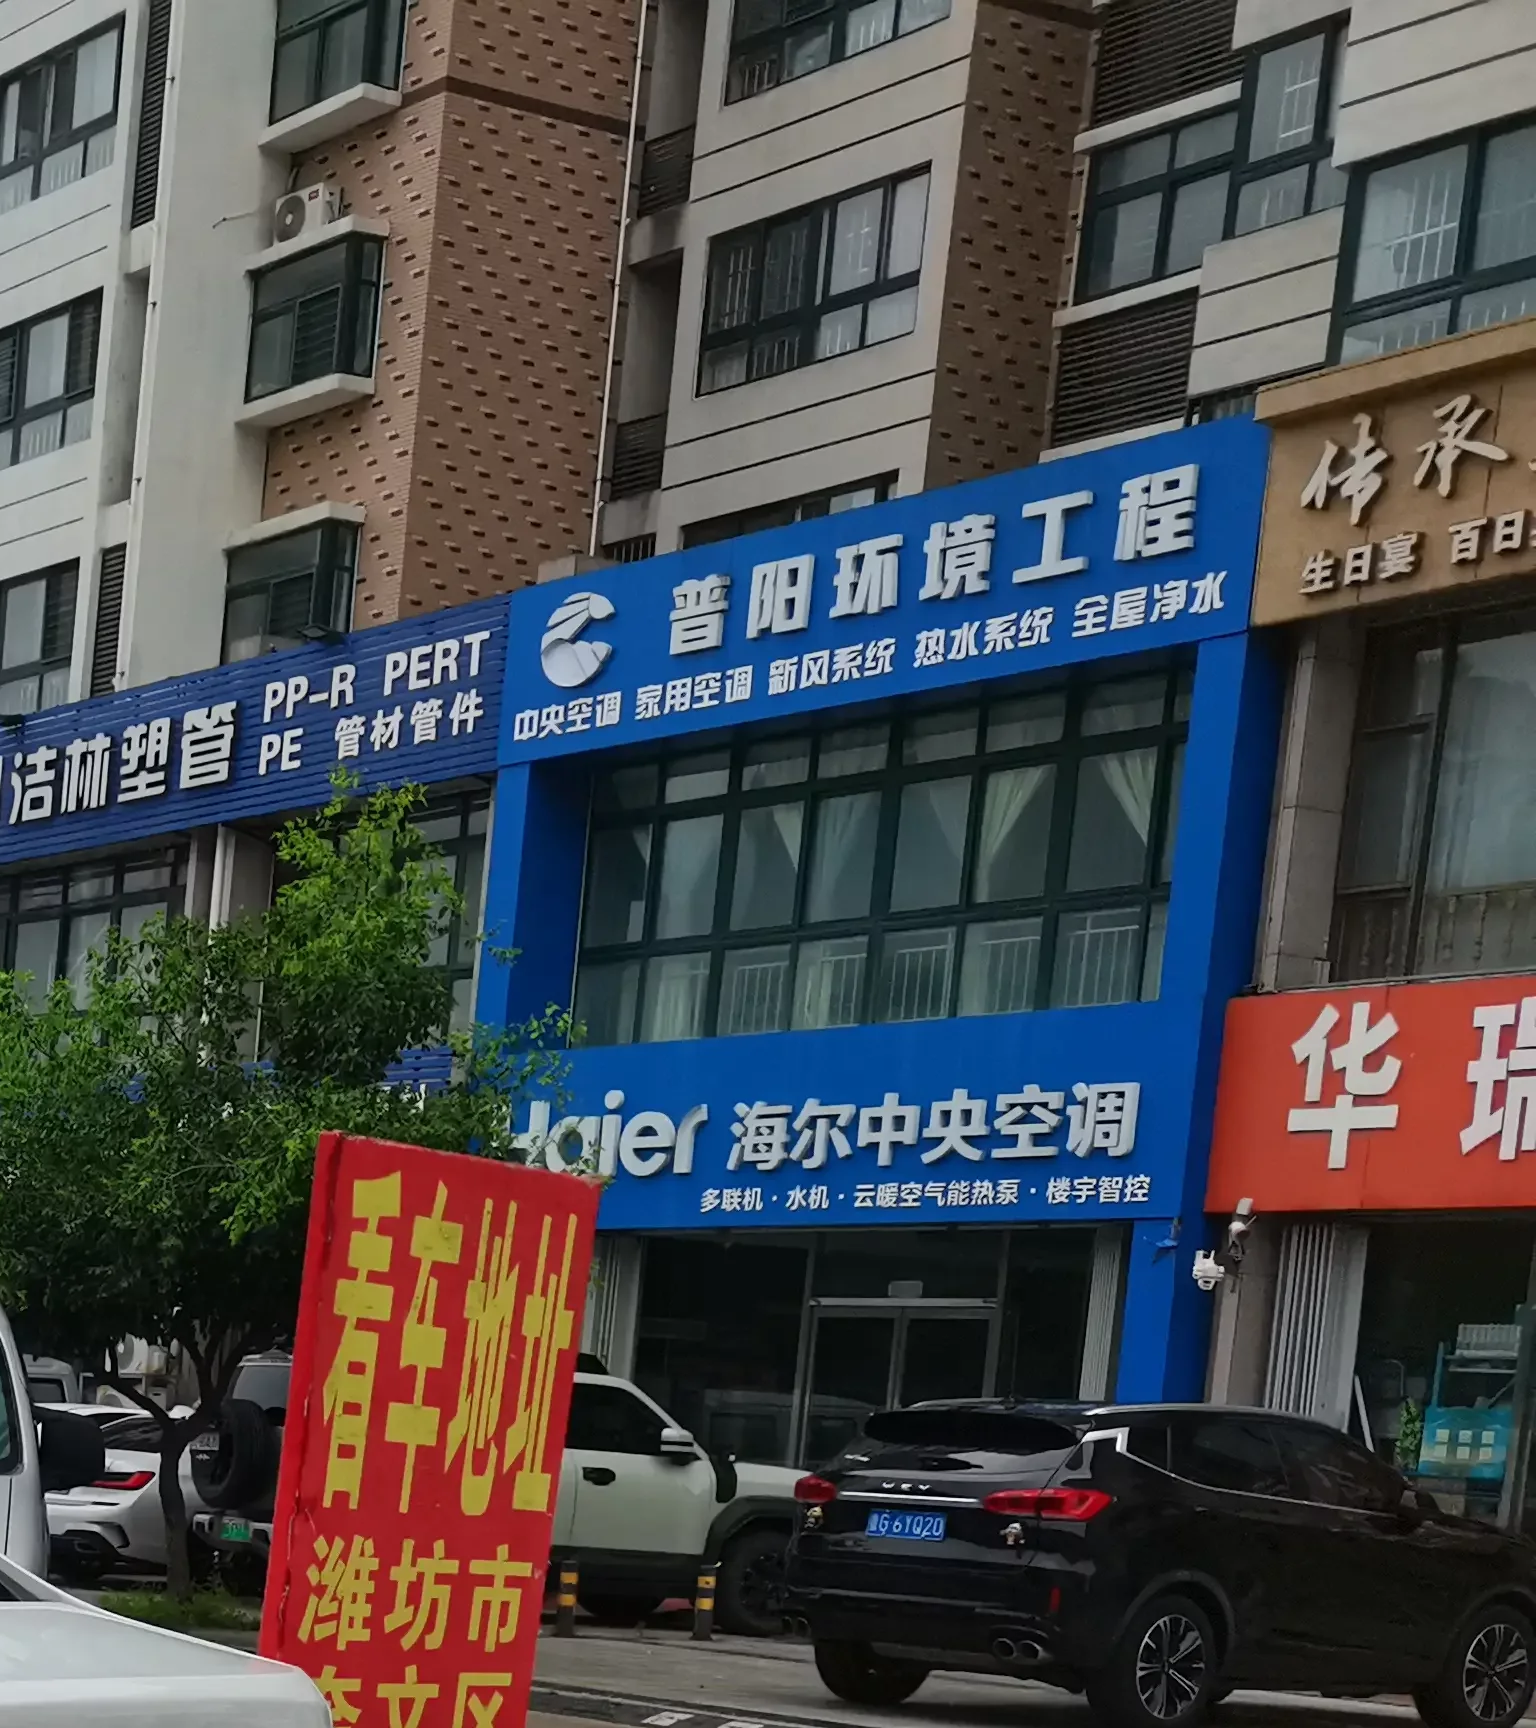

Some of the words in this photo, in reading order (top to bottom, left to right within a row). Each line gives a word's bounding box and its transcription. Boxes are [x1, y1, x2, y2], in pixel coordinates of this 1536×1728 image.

[1300, 392, 1536, 527] 传承
[668, 463, 1201, 657] 普阳环境工程
[1298, 530, 1420, 595] 生日宴
[1448, 509, 1536, 565] 百日
[263, 664, 356, 724] PP-R
[383, 631, 491, 696] PERT
[513, 690, 622, 742] 中央空调
[634, 663, 755, 721] 家用空调
[767, 636, 896, 696] 新风系统
[912, 605, 1056, 670] 热水系统
[1071, 570, 1230, 639] 全屋净水
[8, 700, 237, 825] 洁林塑管
[258, 727, 303, 777] PE
[334, 689, 485, 760] 管材管件
[725, 1081, 1142, 1173] 海尔中央空调
[699, 1188, 764, 1214] 多联机
[786, 1184, 830, 1211] 水机
[852, 1179, 1020, 1209] 云暖空气能热泵
[1045, 1174, 1152, 1204] 楼宇智控
[323, 1171, 577, 1516] 看车地址
[297, 1534, 533, 1653] 潍坊市
